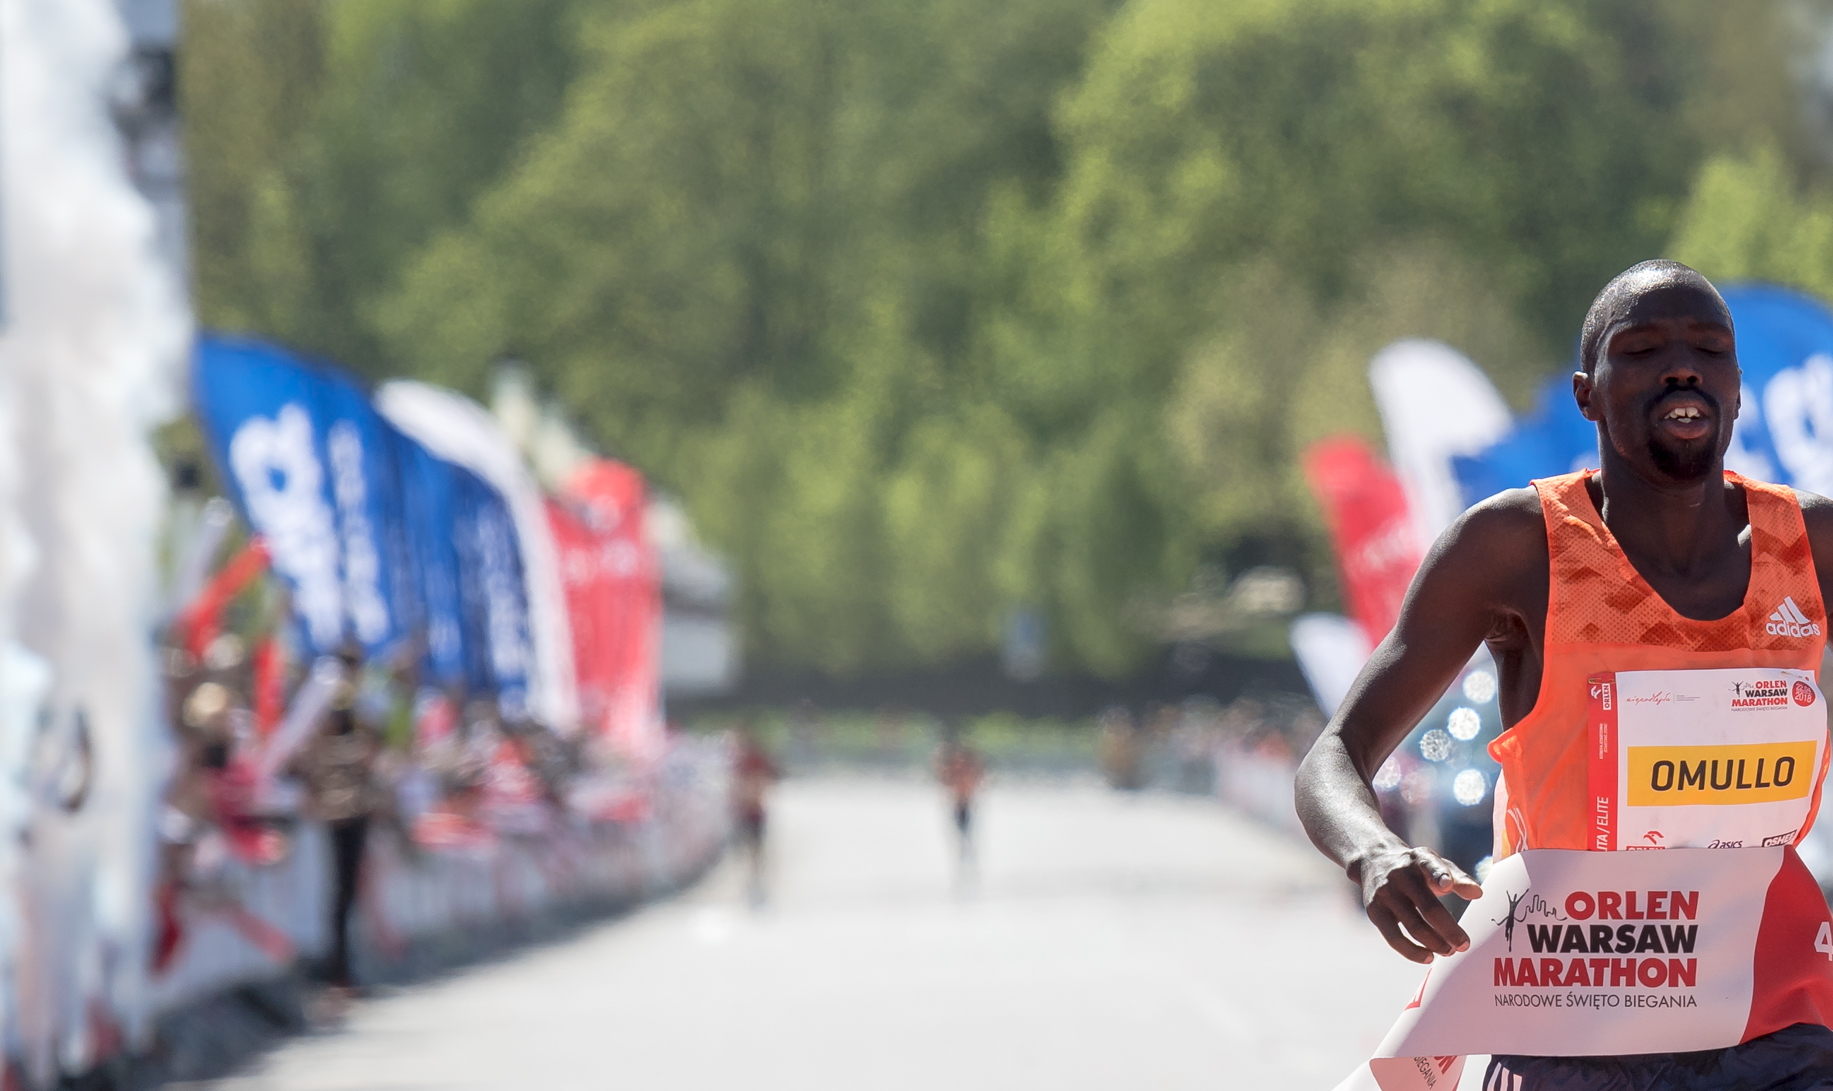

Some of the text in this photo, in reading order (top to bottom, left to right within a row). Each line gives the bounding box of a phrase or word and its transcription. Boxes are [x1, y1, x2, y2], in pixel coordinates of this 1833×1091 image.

[1765, 620, 1820, 637] adidas
[1745, 688, 1788, 698] WARSAW
[1755, 680, 1787, 689] ORLEN
[1731, 697, 1788, 707] MARATHON
[1794, 691, 1812, 703] 2018
[1651, 756, 1795, 791] OMULLO
[1596, 796, 1609, 826] ELITE
[1596, 834, 1608, 851] ITA
[1565, 891, 1699, 920] ORLEN
[1527, 924, 1698, 954] WARSAW
[1494, 958, 1697, 988] MARATHON
[1495, 991, 1697, 1010] NARODOWE ŚWIĘTO BIEGANIA
